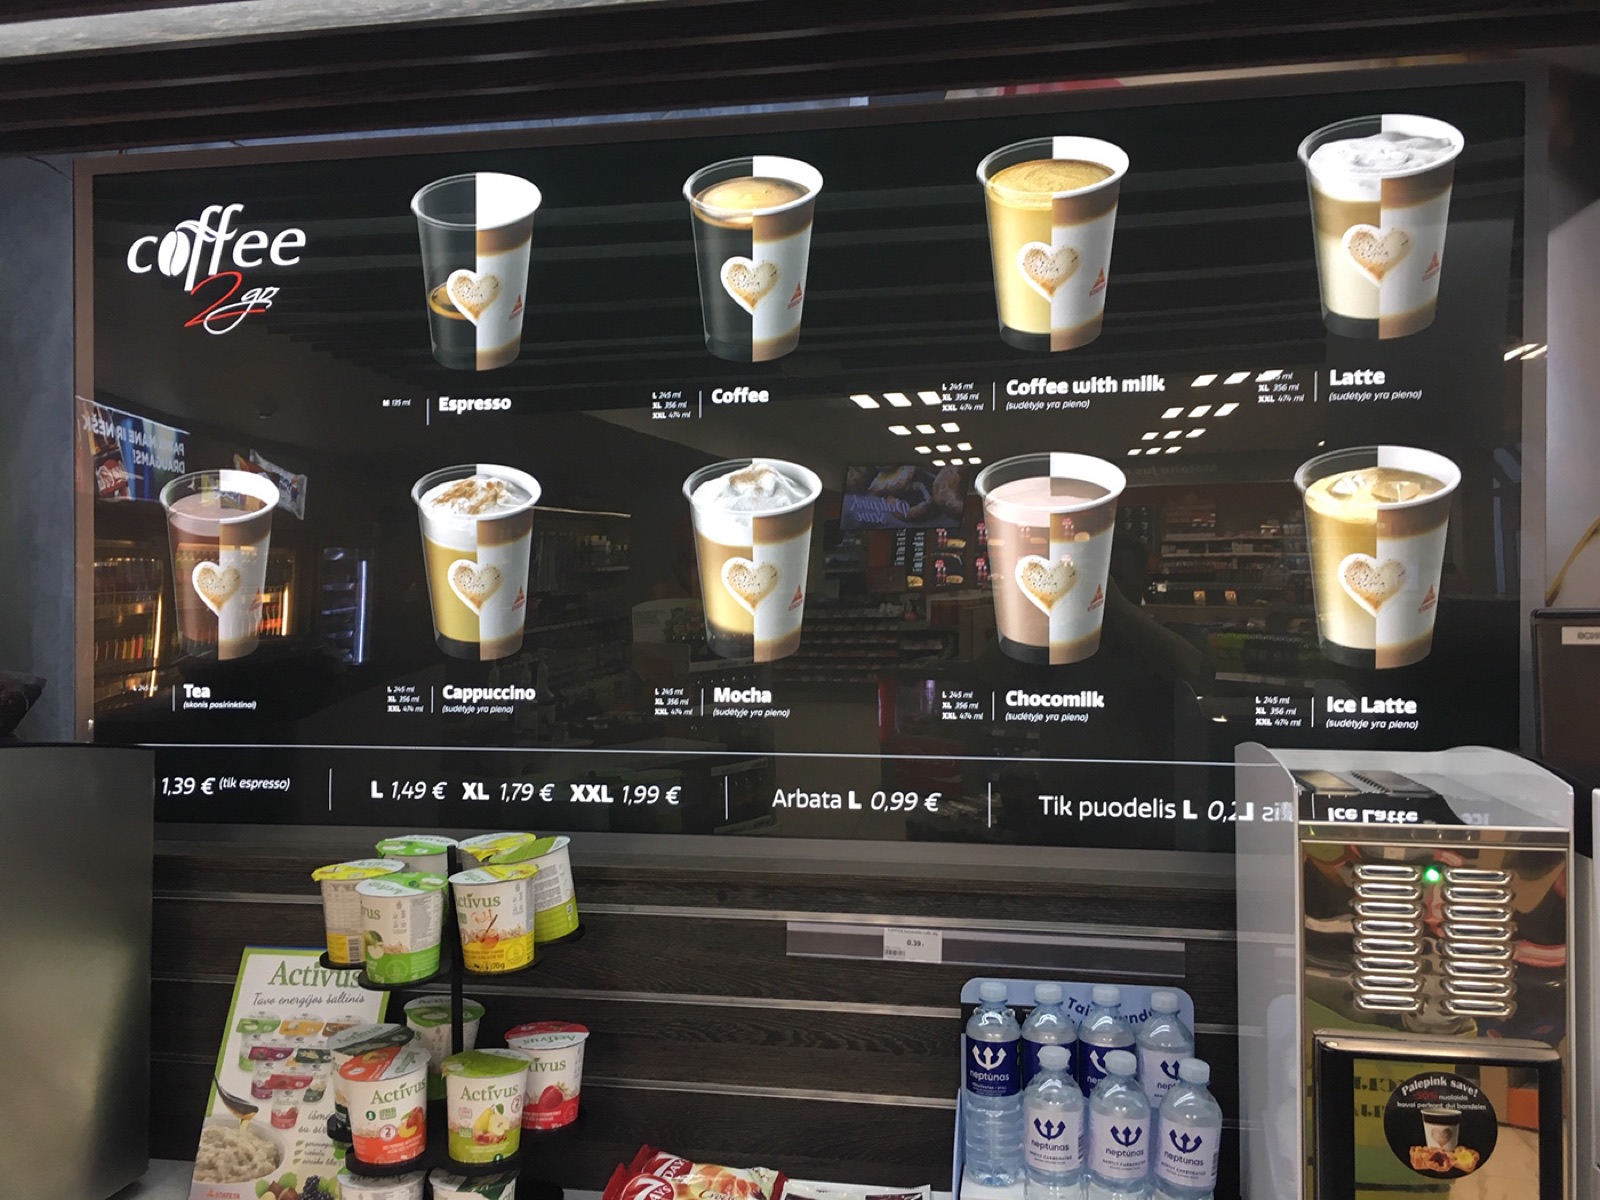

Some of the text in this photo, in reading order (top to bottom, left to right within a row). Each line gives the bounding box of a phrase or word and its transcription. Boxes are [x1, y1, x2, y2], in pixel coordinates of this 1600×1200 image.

[126, 203, 306, 291] coffee
[1329, 369, 1386, 386] Latte
[942, 383, 947, 391] L
[963, 382, 974, 390] ml
[1006, 374, 1166, 395] Coffee with milk
[1258, 384, 1269, 392] XL
[1288, 383, 1300, 391] ml
[652, 391, 657, 399] L
[672, 391, 682, 399] ml
[711, 387, 769, 404] Coffee
[942, 393, 952, 401] XL
[968, 392, 979, 400] ml
[1258, 395, 1275, 403] XXL
[1294, 394, 1305, 403] ml
[1373, 392, 1389, 402] yra
[1391, 390, 1423, 401] pieno)
[439, 396, 512, 415] Espresso
[652, 401, 662, 409] XL
[677, 400, 687, 409] ml
[942, 404, 958, 412] XXL
[973, 403, 984, 411] ml
[1046, 400, 1061, 411] yra
[1062, 399, 1090, 410] pieno)
[652, 411, 667, 419] XXL
[183, 683, 211, 698] Tea
[405, 685, 415, 693] ml
[442, 684, 536, 704] Cappuccino
[654, 688, 660, 696] L
[674, 687, 684, 695] ml
[713, 686, 772, 704] Mocha
[942, 691, 947, 699] L
[962, 690, 974, 699] ml
[183, 700, 208, 710] (skonis
[410, 695, 420, 703] ml
[1005, 690, 1105, 708] Chocomilk
[1255, 696, 1291, 704] L 245 ml
[1326, 695, 1418, 714] Ice Latte
[387, 705, 401, 713] XXL
[476, 706, 489, 714] yra
[489, 705, 514, 715] pieno)
[942, 702, 952, 710] XL
[968, 702, 979, 710] ml
[1255, 707, 1297, 715] XL 356 ml
[749, 709, 763, 718] yra
[764, 708, 791, 718] pieno)
[942, 712, 957, 720] XXL
[973, 712, 984, 720] ml
[1044, 713, 1059, 723] yra
[1060, 713, 1089, 723] pieno)
[1255, 718, 1273, 726] XXL
[1290, 718, 1302, 726] ml
[1370, 720, 1387, 730] yra
[1388, 719, 1419, 731] pieno)
[161, 776, 291, 797] 1,39 € (tik espresso)
[370, 780, 682, 806] L 1,49 € XL 1,79 € XXL 1,99 €
[772, 788, 942, 813] Arbata L 0,99 €
[1038, 795, 1073, 816] Tik
[1079, 797, 1177, 821] puodelis
[1182, 799, 1199, 819] L
[456, 893, 501, 908] ctivus
[267, 960, 362, 988] Activus
[252, 992, 275, 1006] Tavo
[278, 994, 323, 1008] energijos
[529, 1057, 567, 1072] tivus
[371, 1078, 426, 1105] Activus
[1401, 1075, 1448, 1097] Palepink
[1449, 1079, 1479, 1098] save!
[460, 1085, 519, 1101] Activus
